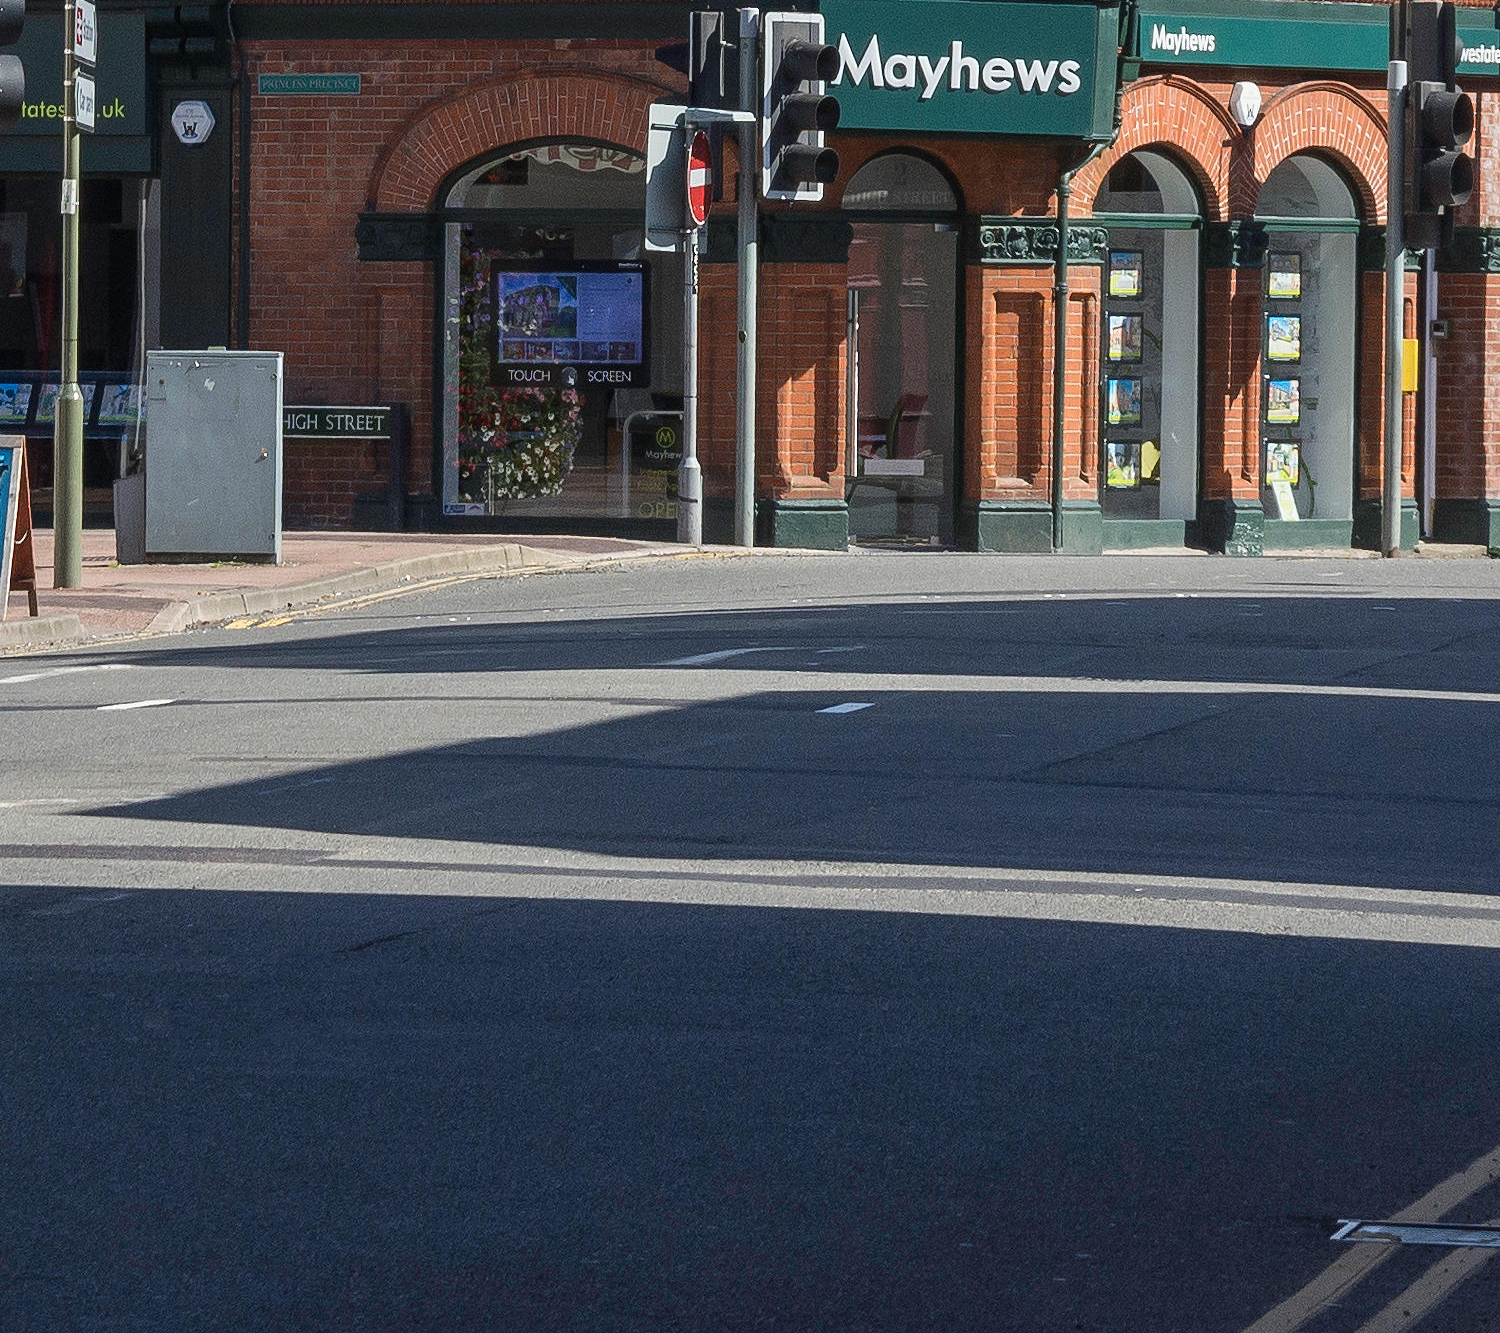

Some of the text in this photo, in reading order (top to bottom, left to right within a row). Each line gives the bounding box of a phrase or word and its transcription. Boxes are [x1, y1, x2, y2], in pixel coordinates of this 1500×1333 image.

[1152, 24, 1216, 55] Mayhews
[830, 33, 1081, 99] Mayhews
[507, 369, 632, 383] TOUCH SCREEN
[283, 413, 385, 431] HIGH STREET
[645, 450, 682, 461] Mayhew
[639, 501, 677, 519] OPE
